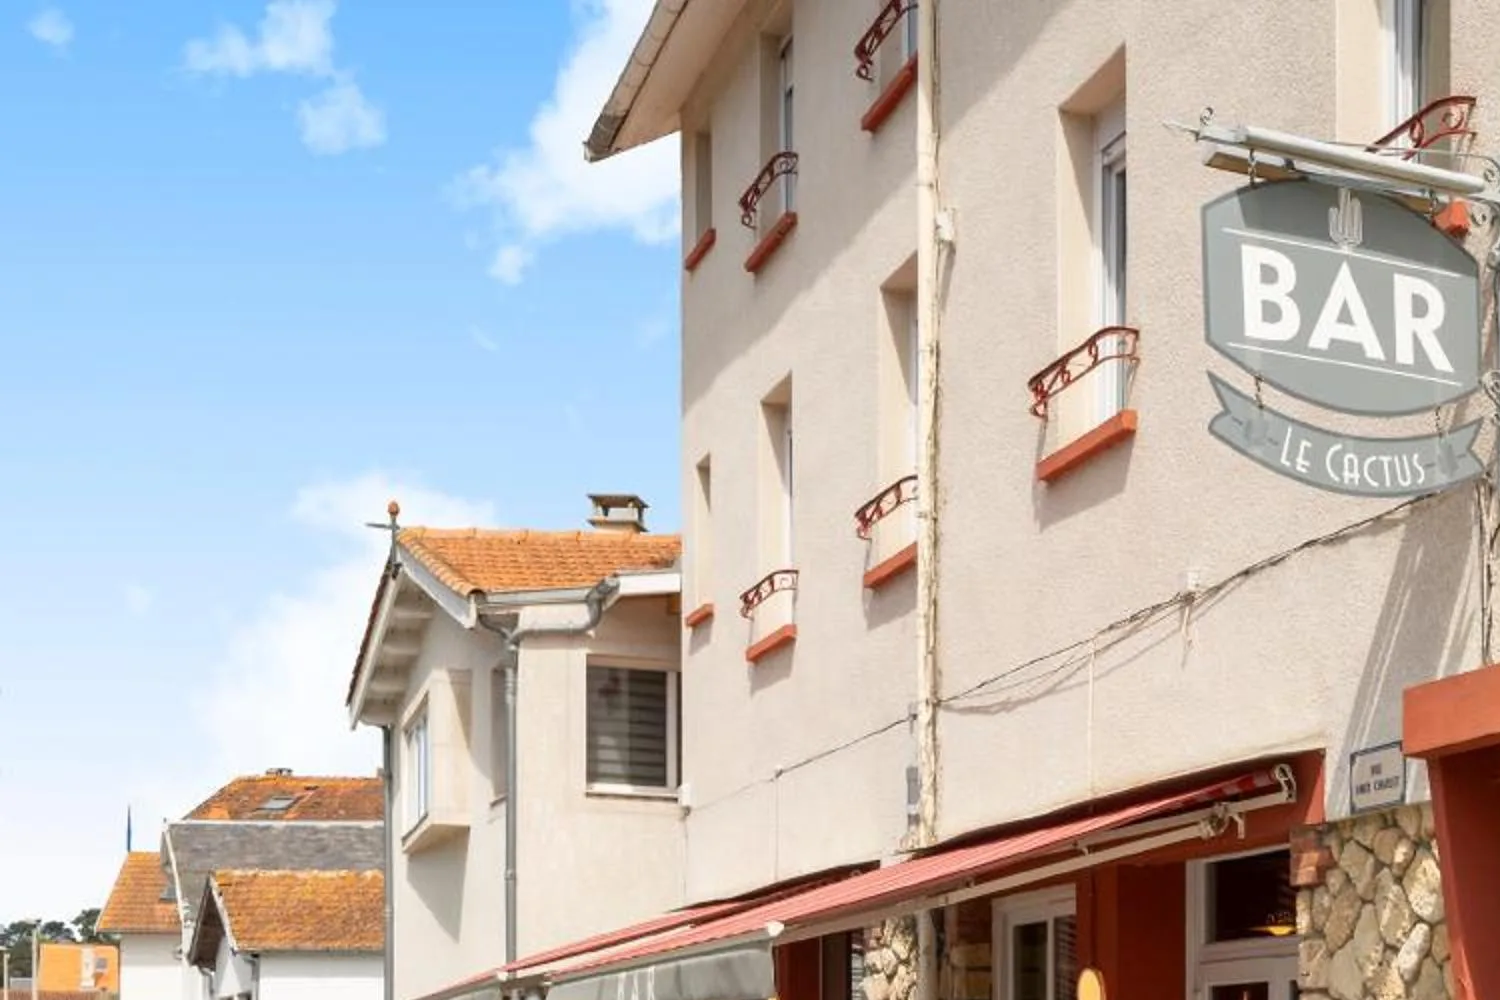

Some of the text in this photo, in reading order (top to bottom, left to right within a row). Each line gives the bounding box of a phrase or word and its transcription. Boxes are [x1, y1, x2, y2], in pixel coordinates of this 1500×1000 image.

[1240, 243, 1454, 374] BAR
[1280, 424, 1425, 487] LE CACTUS
